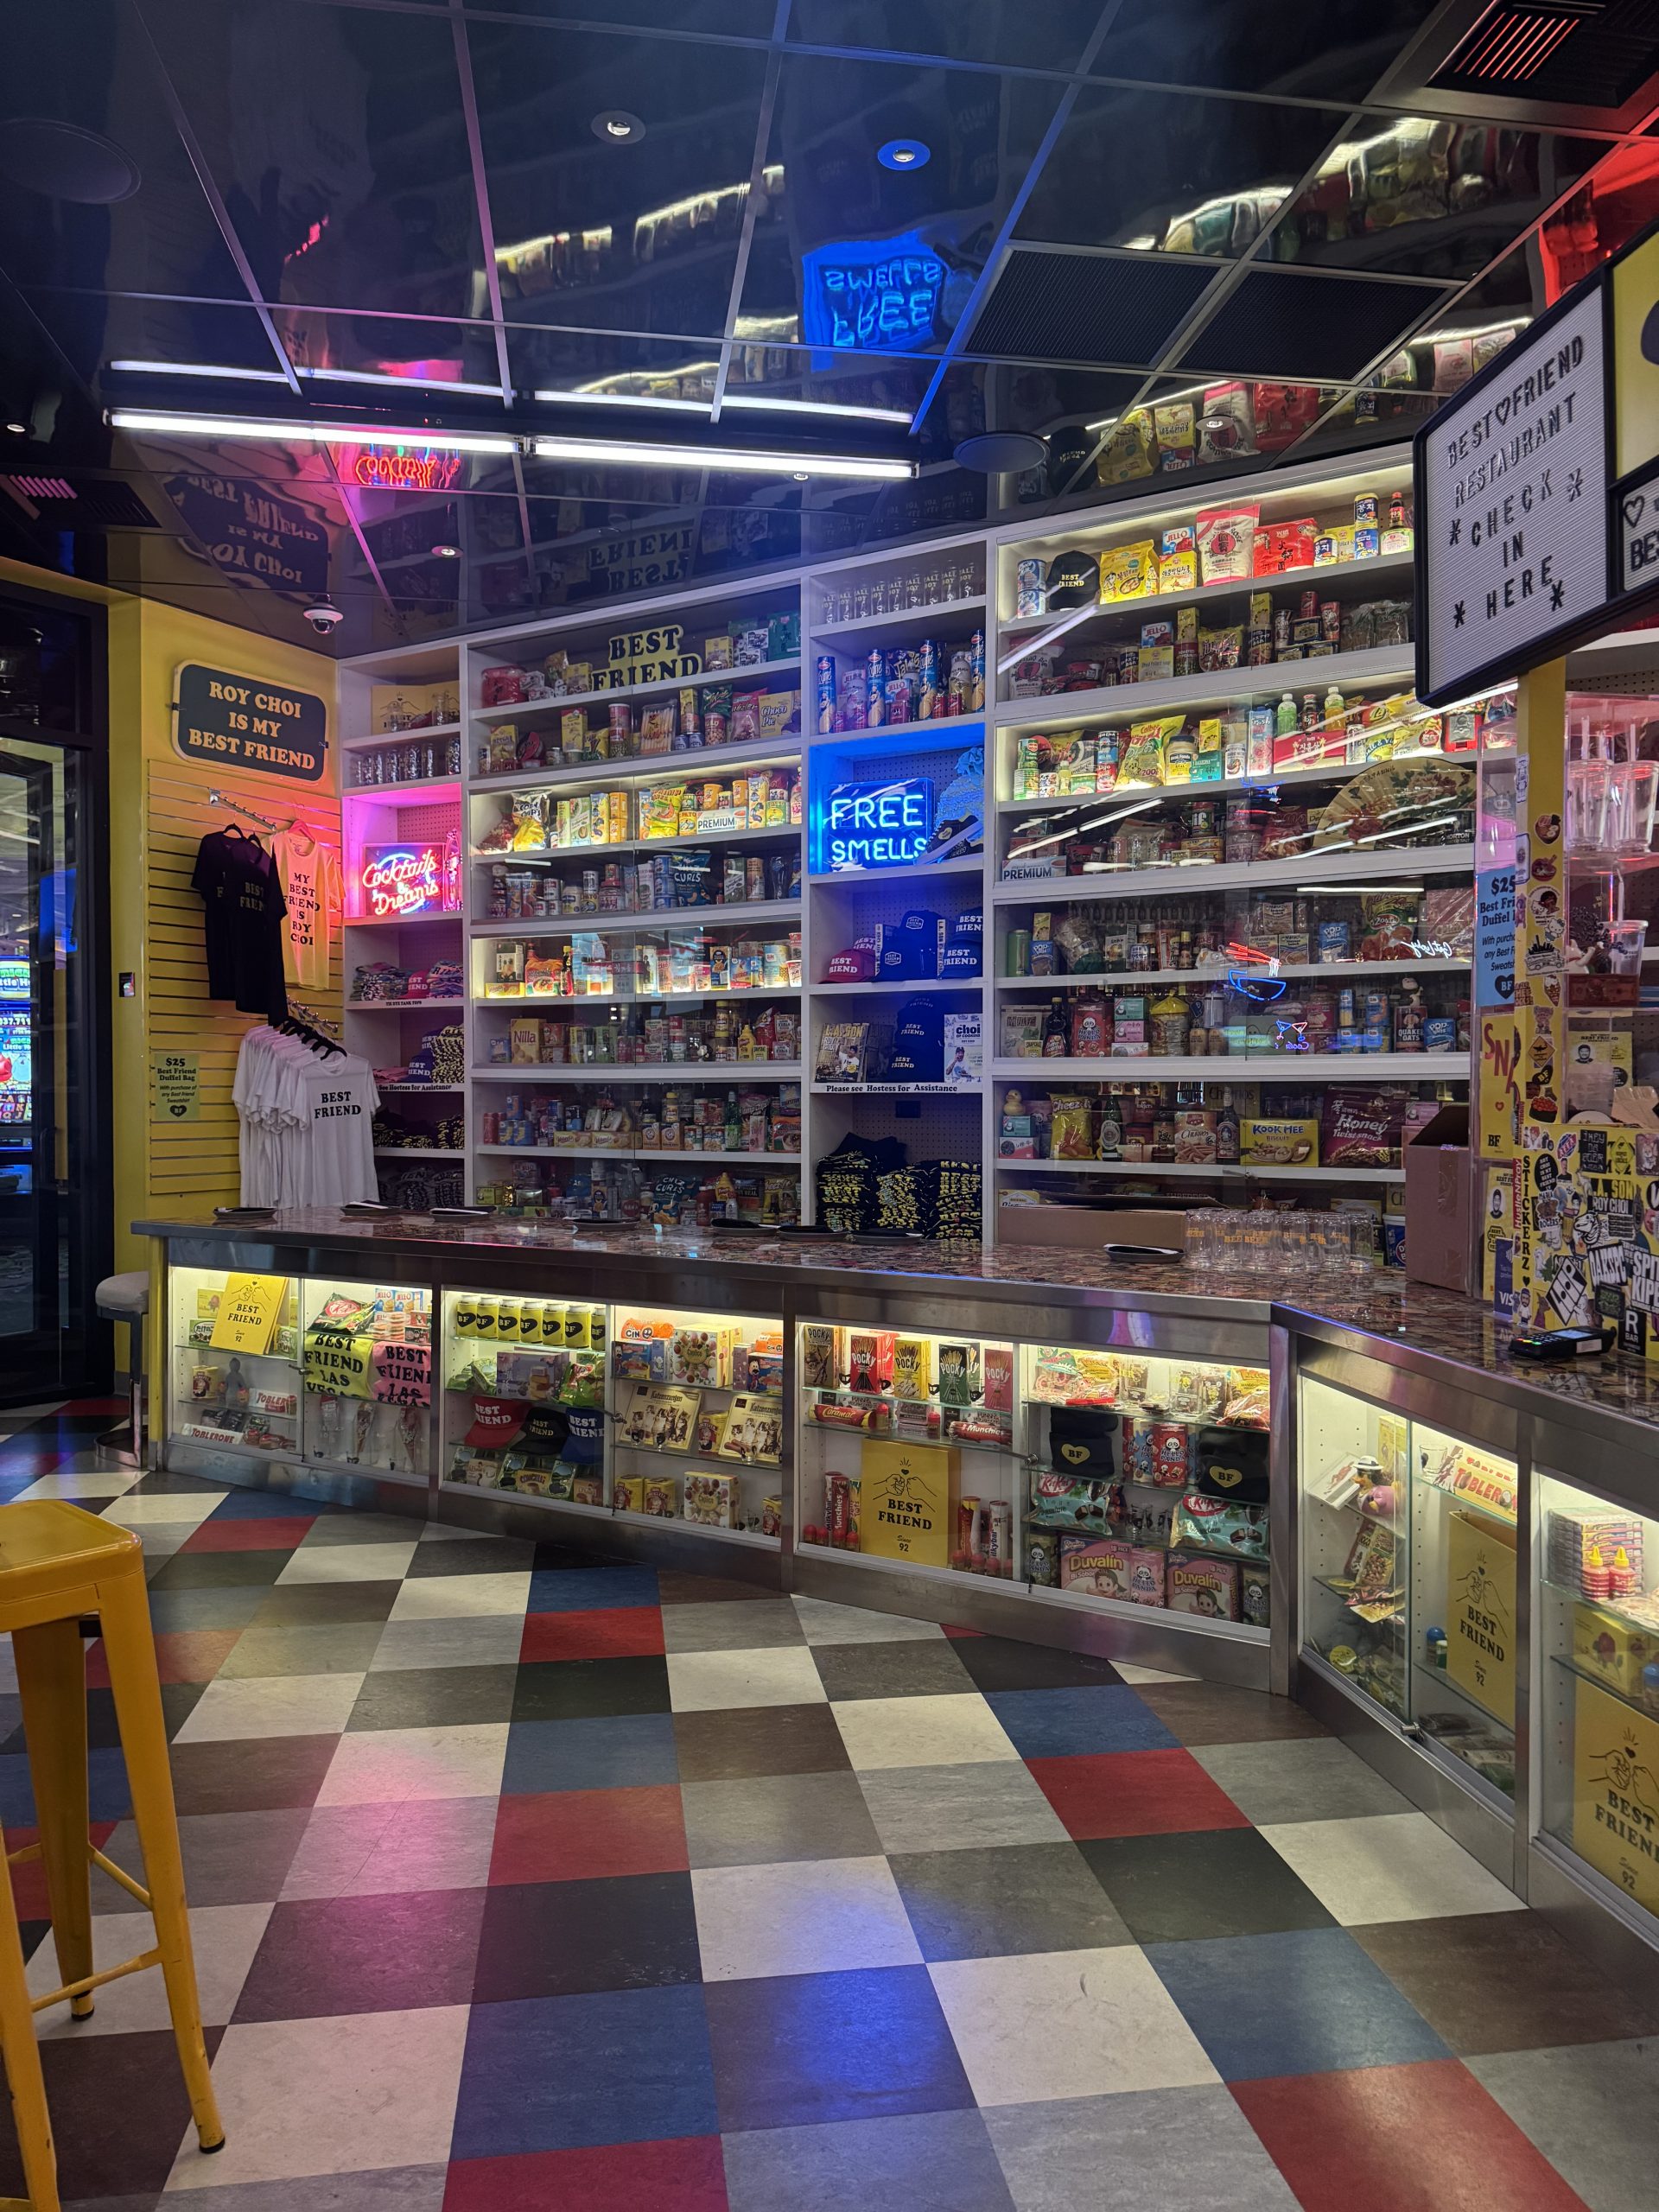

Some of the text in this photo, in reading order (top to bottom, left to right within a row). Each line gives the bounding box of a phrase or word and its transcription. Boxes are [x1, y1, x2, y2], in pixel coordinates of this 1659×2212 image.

[1447, 334, 1584, 468] BEST FRIEND
[1455, 391, 1578, 509] RESTAURANT
[1471, 468, 1553, 548] CHECK
[1503, 531, 1524, 569] IN
[1486, 555, 1554, 620] HERE
[609, 626, 682, 660] BEST
[591, 656, 701, 691] FRIEND
[209, 681, 302, 718] ROY CHOI
[761, 706, 787, 716] Choco
[229, 712, 282, 737] IS MY
[761, 715, 775, 728] Pie
[188, 728, 315, 769] BEST FRIEND
[831, 794, 924, 830] FREE
[698, 817, 734, 829] PREMIUM
[831, 837, 927, 861] SMELLS
[362, 849, 437, 888] Cocktails
[1003, 868, 1052, 880] PREMIUM
[294, 873, 310, 884] MY
[675, 873, 702, 883] CURLS
[289, 884, 315, 897] BEST
[372, 878, 439, 916] Dreams
[283, 895, 320, 912] FRIEND
[1479, 896, 1515, 913] Best Fri
[1482, 911, 1510, 926] Duffel
[956, 924, 983, 932] FRIEN
[1482, 937, 1496, 946] With
[1484, 948, 1510, 960] any Best
[1501, 982, 1511, 991] BF
[514, 1030, 537, 1044] Nilla
[956, 1024, 981, 1034] choi
[166, 1058, 186, 1066] $25
[1537, 1070, 1549, 1080] BF
[321, 1090, 352, 1104] BEST
[314, 1104, 362, 1119] FRIEND
[1253, 1125, 1281, 1135] KOOK
[1336, 1115, 1389, 1134] Honey
[1355, 1131, 1382, 1141] snack
[1488, 1135, 1501, 1147] BF
[656, 1185, 685, 1194] CURLS
[1611, 1181, 1634, 1199] SON
[1522, 1155, 1531, 1269] STICKERZ
[1592, 1198, 1629, 1214] ROY CHOI
[237, 1303, 259, 1313] BEST
[228, 1313, 262, 1325] FRIEND
[1626, 1311, 1638, 1334] R
[807, 1327, 831, 1339] POCKY
[1625, 1332, 1638, 1343] BAR
[315, 1334, 356, 1351] BEST
[304, 1351, 363, 1374] FRIEND
[385, 1346, 427, 1364] BEST
[851, 1352, 877, 1367] POCKY
[895, 1357, 920, 1372] POCKY
[940, 1362, 966, 1377] POCKY
[320, 1370, 350, 1387] LAS
[985, 1366, 1011, 1382] POCKY
[389, 1383, 423, 1399] LAS
[475, 1405, 500, 1415] BEST
[823, 1407, 855, 1419] Caramac
[532, 1419, 550, 1428] BEST
[569, 1415, 596, 1427] BEST
[192, 1427, 235, 1444] TOBLERONE
[1068, 1449, 1083, 1459] BF
[1218, 1471, 1234, 1482] BF
[887, 1498, 923, 1515] BEST
[878, 1510, 932, 1530] FRIEND
[899, 1543, 909, 1553] 92
[1069, 1554, 1123, 1571] Duvalín
[1468, 1605, 1497, 1637] BEST
[1459, 1620, 1505, 1663] FRIEND
[1476, 1670, 1485, 1687] 92
[1607, 1788, 1656, 1834] BEST
[1594, 1802, 1659, 1866] FRIEN
[1621, 1870, 1637, 1891] 92
